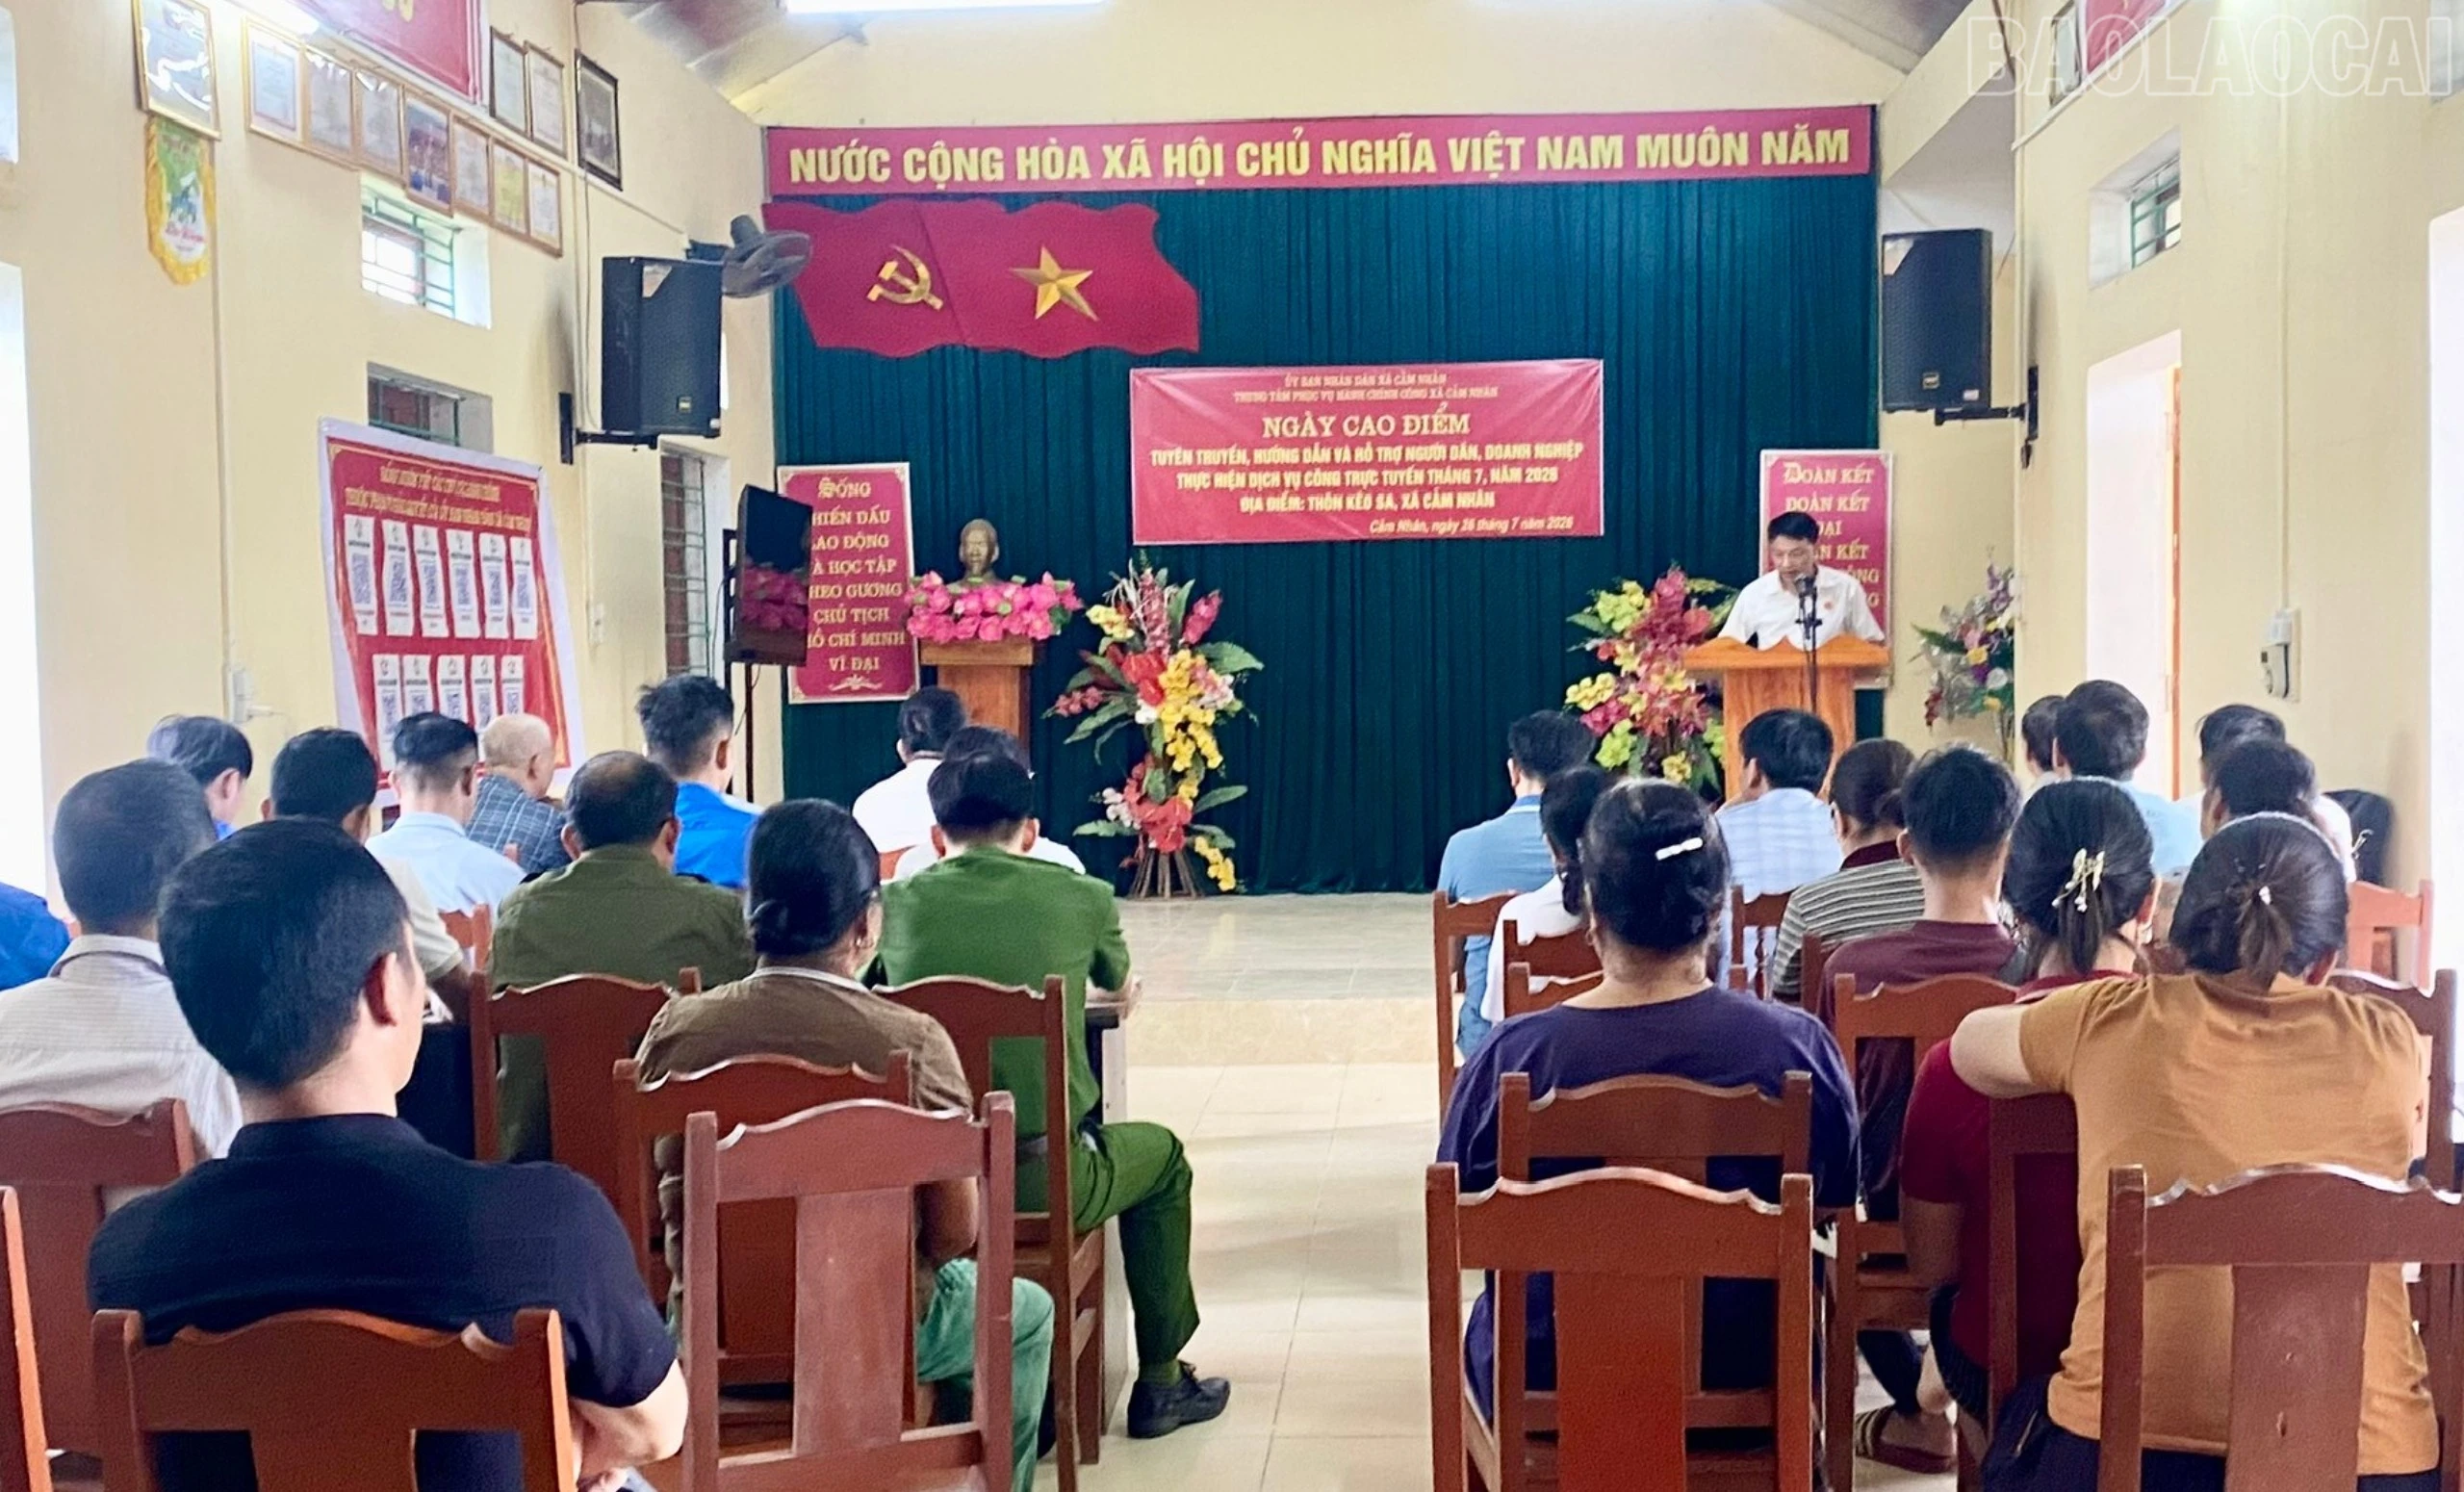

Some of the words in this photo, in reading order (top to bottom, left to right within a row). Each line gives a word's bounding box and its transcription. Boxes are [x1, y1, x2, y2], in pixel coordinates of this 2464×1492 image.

[790, 138, 890, 182] NƯỚC
[903, 140, 1004, 191] CỘNG
[1016, 138, 1091, 180] HÒA
[1102, 139, 1152, 178] XÃ
[1164, 135, 1223, 185] HỘI
[1237, 126, 1310, 176] CHỦ
[1322, 132, 1437, 175] NGHĨA
[1448, 130, 1526, 179] VIỆT
[1537, 134, 1624, 170] NAM
[1636, 126, 1749, 169] MUÔN
[1761, 123, 1849, 165] NĂM
[1262, 411, 1336, 439] NGÀY
[1342, 414, 1396, 438] CAO
[1401, 401, 1471, 435] ĐIỂM
[1151, 446, 1194, 466] TUYÊN
[1254, 445, 1299, 464] HƯỚNG
[1302, 442, 1332, 464] DẪN
[1334, 445, 1351, 463] VÀ
[1376, 446, 1402, 465] TRỢ
[1405, 443, 1447, 462] NGƯỜI
[1485, 444, 1531, 460] DOANH
[1534, 439, 1583, 462] NGHIỆP
[1176, 471, 1211, 492] THỰC
[1214, 469, 1245, 492] HIỆN
[1248, 471, 1280, 492] DỊCH
[1283, 471, 1302, 491] VỤ
[1304, 468, 1341, 488] CÔNG
[1345, 469, 1378, 489] TRỰC
[1382, 465, 1424, 486] TUYẾN
[1426, 465, 1472, 485] THÁNG
[1490, 465, 1523, 483] NĂM
[1784, 462, 1836, 484] ĐOÀN
[1840, 462, 1875, 484] KẾT
[819, 476, 871, 499] SỐNG
[1240, 496, 1264, 515] ĐỊA
[1308, 491, 1344, 511] THÔN
[1400, 489, 1420, 509] XÃ
[1456, 488, 1495, 509] NHÂN
[1836, 489, 1871, 512] KẾT
[811, 504, 852, 527] HIẾN
[857, 503, 890, 525] ĐẤU
[1432, 518, 1459, 535] ngày
[1476, 517, 1507, 534] tháng
[1511, 516, 1521, 530] 7
[811, 534, 839, 551] AO
[843, 530, 889, 553] ĐỘNG
[1835, 537, 1870, 559] KẾT
[812, 559, 824, 575] À
[829, 561, 861, 578] HỌC
[864, 556, 897, 578] TẬP
[809, 583, 843, 598] HEO
[846, 581, 903, 598] GƯƠNG
[813, 603, 845, 624] CHỦ
[850, 606, 889, 626] TỊCH
[829, 629, 856, 648] CHÍ
[861, 630, 906, 646] MINH
[829, 655, 845, 671] VĨ
[851, 657, 880, 673] ĐẠI
